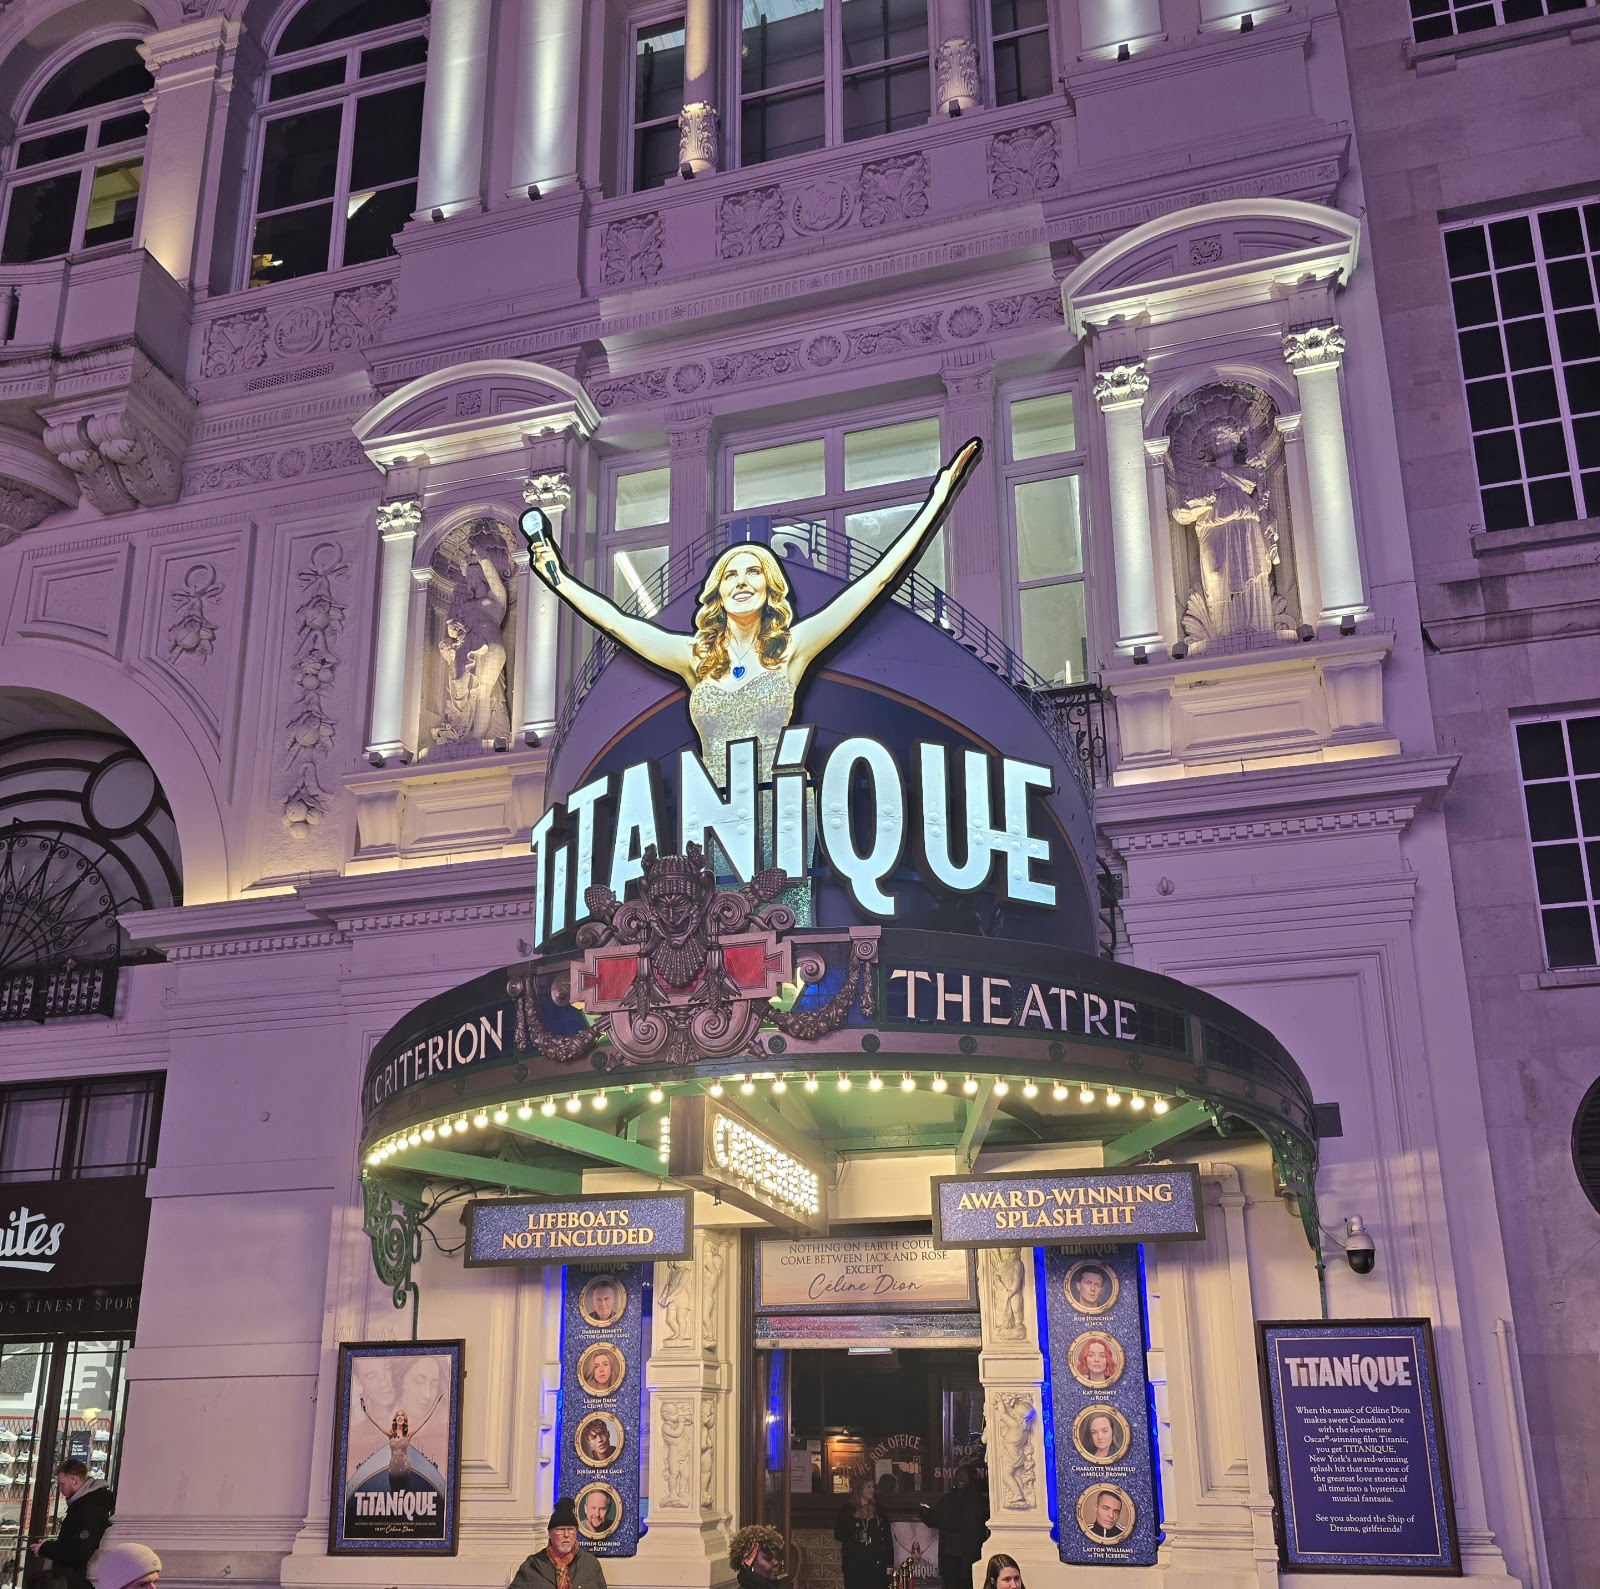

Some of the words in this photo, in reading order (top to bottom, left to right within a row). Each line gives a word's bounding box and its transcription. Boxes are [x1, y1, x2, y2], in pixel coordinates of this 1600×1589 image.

[374, 1010, 504, 1104] CRITERION
[889, 969, 1137, 1040] THEATRE
[957, 1183, 1173, 1210] AWARD-WINNING
[528, 1210, 629, 1230] LIFEBOATS
[995, 1209, 1083, 1229] SPLASH
[1091, 1206, 1136, 1225] HIT
[501, 1232, 545, 1250] NOT
[550, 1228, 654, 1247] INCLUDED
[789, 1243, 841, 1254] NOTHING
[843, 1242, 860, 1252] ON
[864, 1241, 899, 1250] EARTH
[902, 1240, 934, 1249] COUL
[781, 1256, 811, 1266] COME
[814, 1254, 862, 1264] BETWEEN
[865, 1252, 891, 1263] JACK
[894, 1252, 918, 1261] AND
[922, 1251, 950, 1260] ROSE.
[845, 1264, 884, 1274] EXCEPT
[808, 1273, 870, 1300] Céline
[873, 1274, 922, 1295] Dion
[26, 1299, 84, 1312] FINEST
[95, 1297, 140, 1311] SPOR
[1296, 1406, 1318, 1414] When
[1320, 1406, 1331, 1414] the
[1356, 1406, 1364, 1414] of
[1365, 1406, 1389, 1414] Céline
[1391, 1406, 1410, 1414] Dion
[1363, 1435, 1377, 1443] film
[1379, 1436, 1409, 1444] Titanic,
[956, 1445, 972, 1455] NO
[1343, 1445, 1396, 1454] TITANIQUE,
[853, 1461, 871, 1477] THE
[869, 1442, 889, 1464] BOX
[888, 1434, 920, 1449] OFFICE
[1309, 1455, 1327, 1463] New
[1353, 1455, 1408, 1464] award-winning
[1310, 1465, 1333, 1473] splash
[1401, 1465, 1409, 1473] of
[1313, 1474, 1325, 1482] the
[1318, 1484, 1326, 1492] all
[1370, 1484, 1406, 1493] hysterical
[1388, 1515, 1405, 1524] Ship
[1330, 1524, 1360, 1533] Dreams,
[1362, 1525, 1402, 1533] girlfriends!
